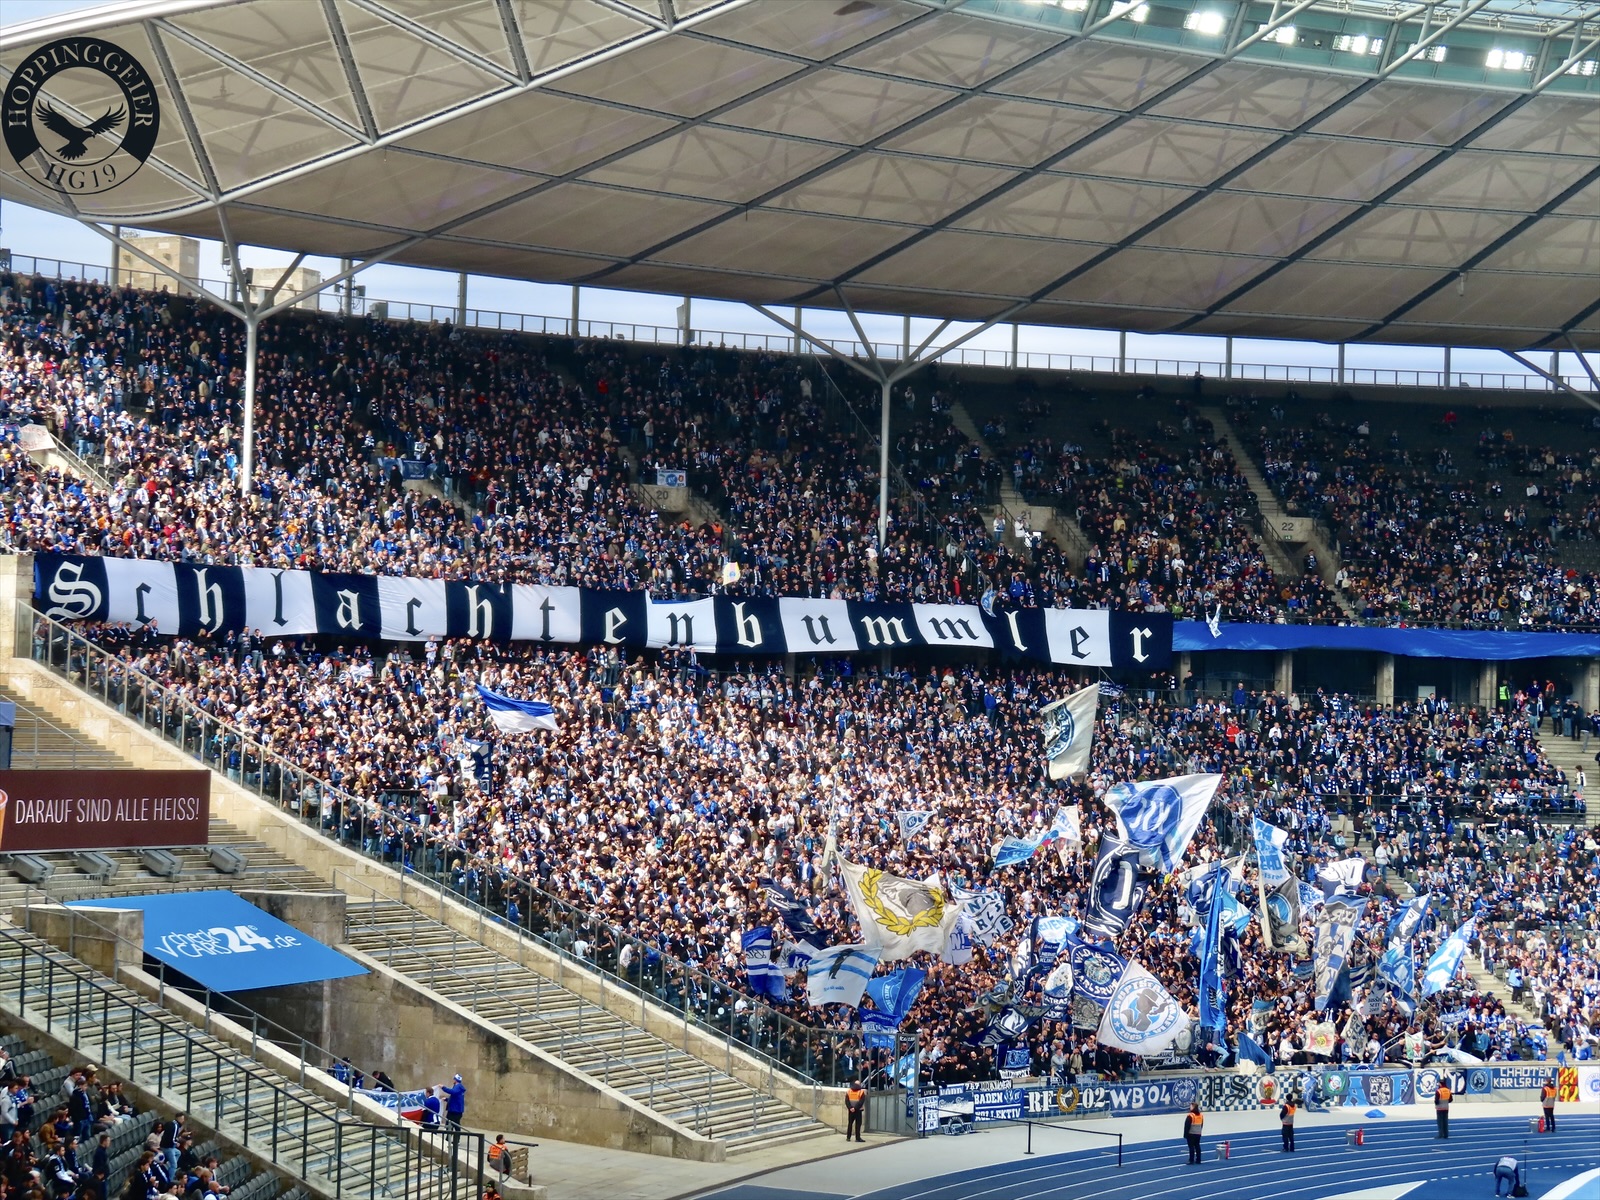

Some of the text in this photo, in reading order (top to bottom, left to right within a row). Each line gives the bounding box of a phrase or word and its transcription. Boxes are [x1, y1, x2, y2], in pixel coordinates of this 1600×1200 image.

[656, 490, 669, 500] 20
[1281, 522, 1294, 531] 22
[46, 561, 1153, 664] Schlachtenbummler
[15, 797, 200, 824] DARAUF SIND ALLE HEISS!
[1500, 1067, 1553, 1078] CHAOTEN
[974, 1091, 1003, 1105] BADEN
[1028, 1087, 1106, 1113] RF 02
[1109, 1085, 1170, 1109] WB'04
